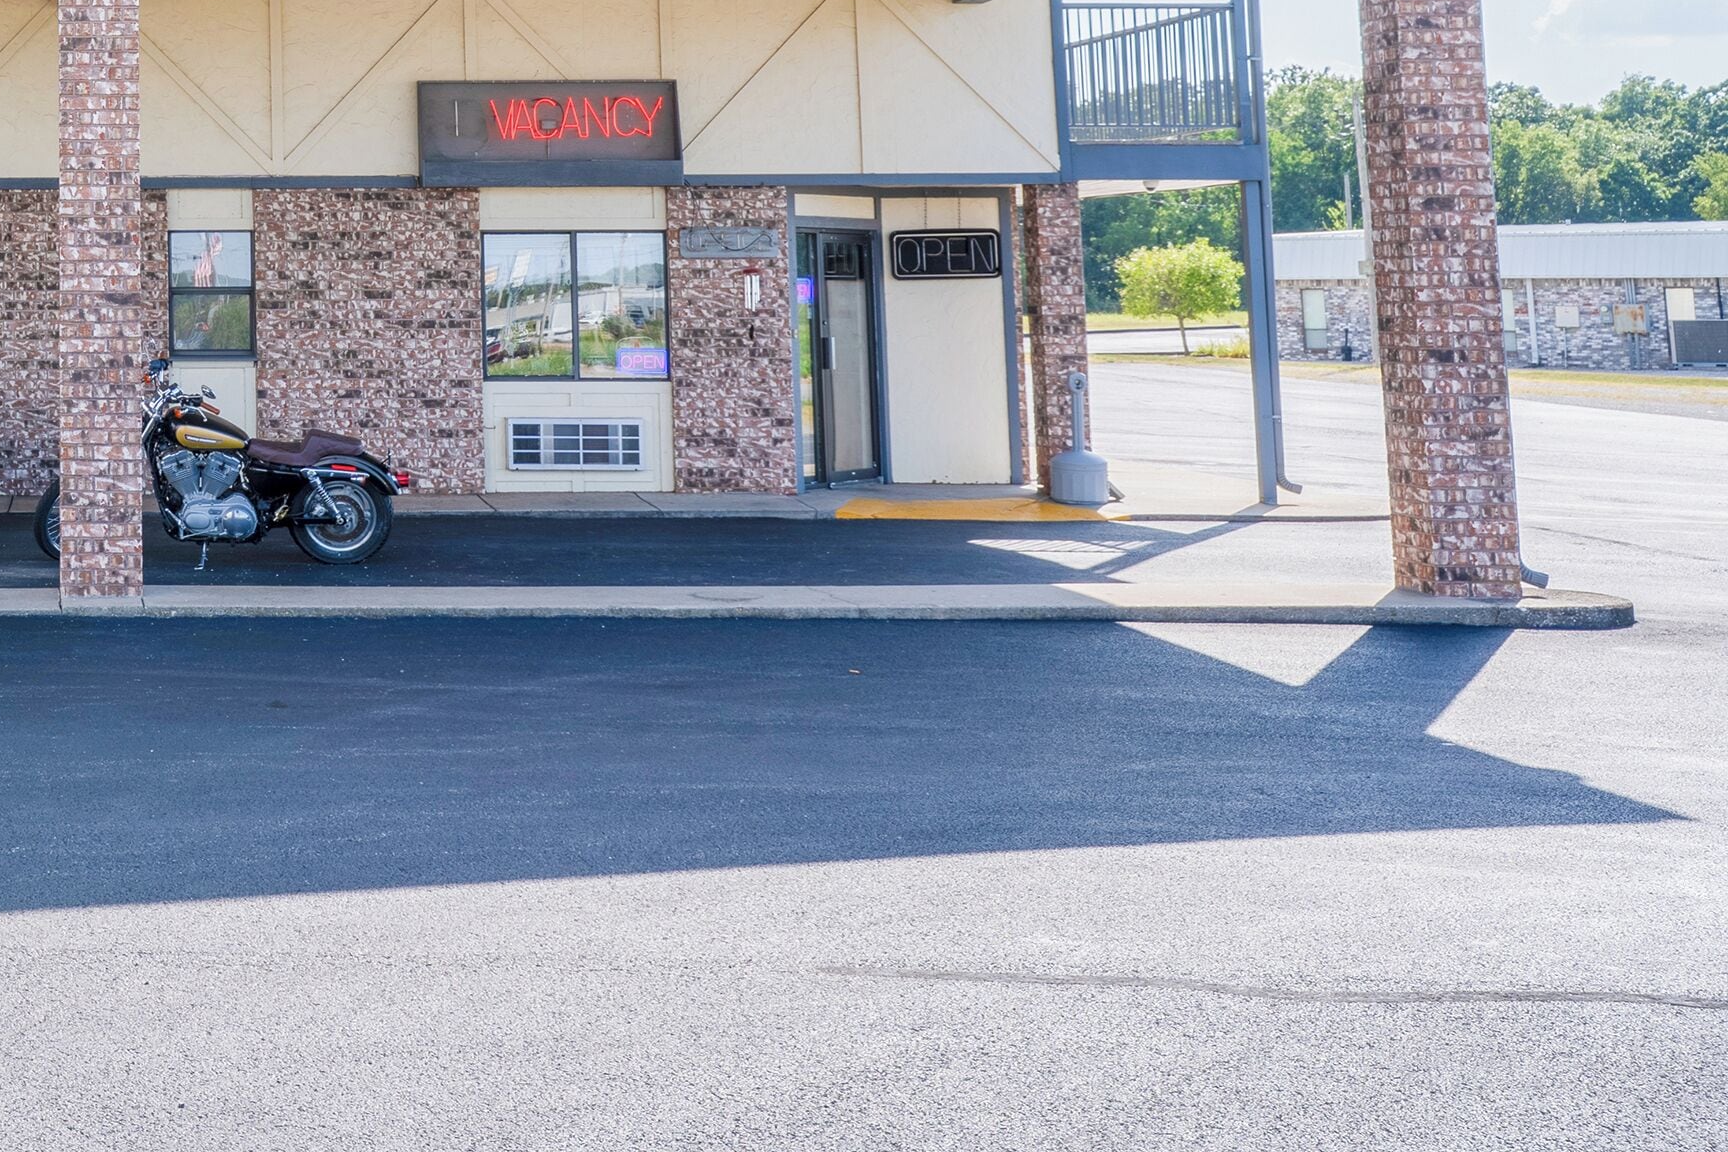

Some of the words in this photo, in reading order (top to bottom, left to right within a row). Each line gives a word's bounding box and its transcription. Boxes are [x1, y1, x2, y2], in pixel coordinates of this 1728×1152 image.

[489, 96, 663, 140] VACANCY
[898, 236, 994, 274] OPEN
[620, 354, 665, 369] OPEN
